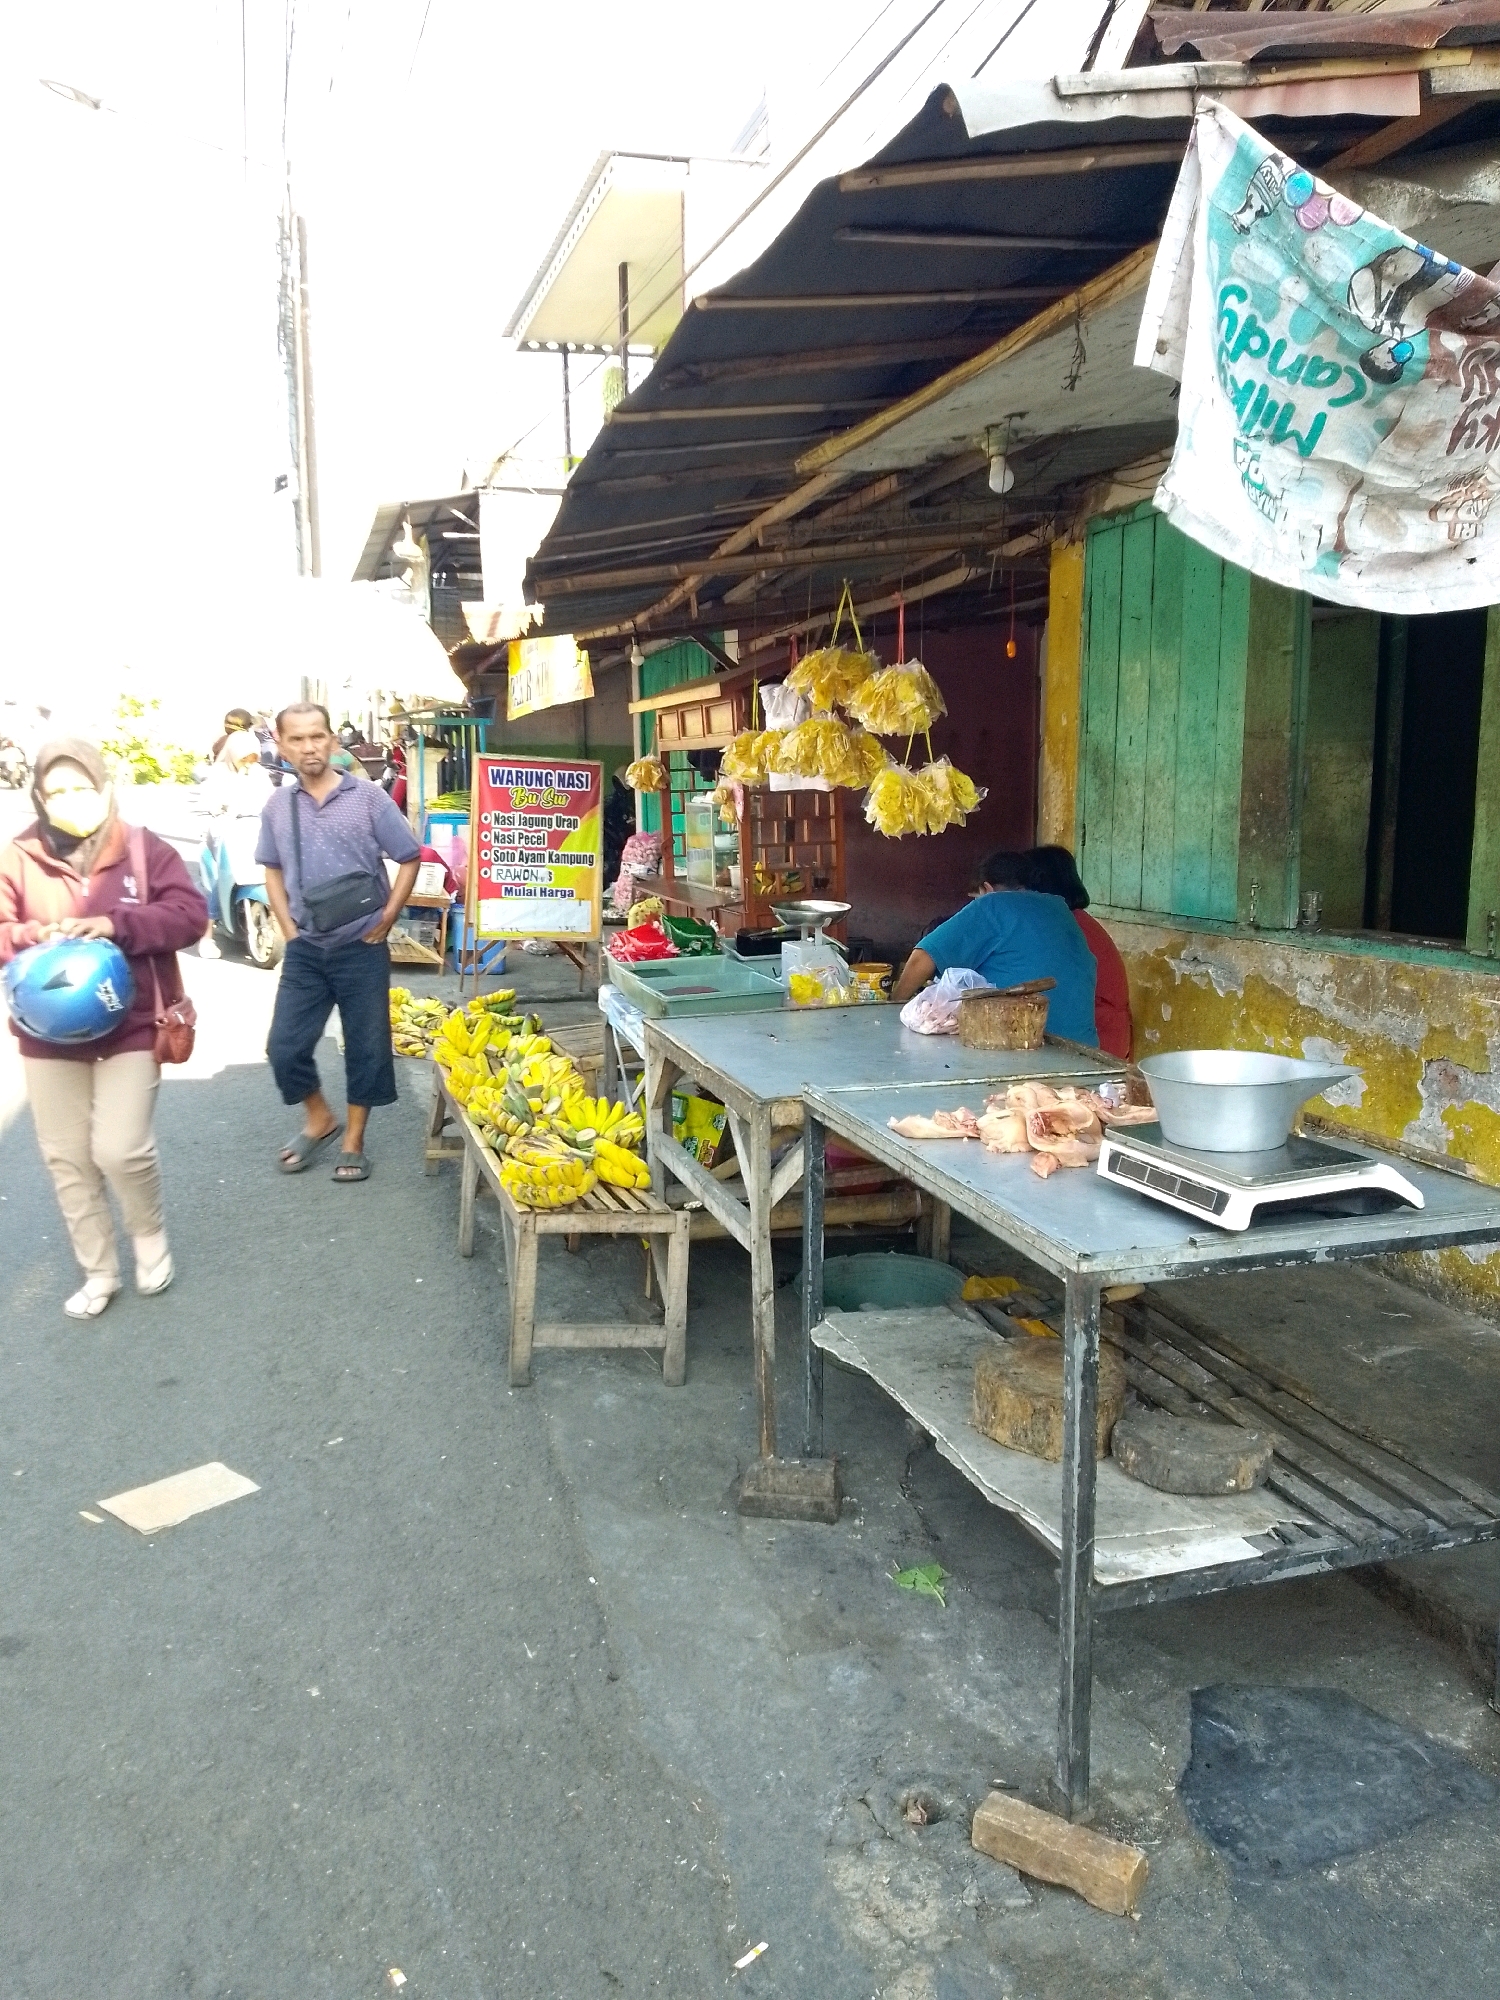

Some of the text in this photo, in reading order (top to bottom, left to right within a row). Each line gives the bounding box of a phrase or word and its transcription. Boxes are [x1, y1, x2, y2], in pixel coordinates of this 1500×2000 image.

[1217, 284, 1367, 408] Candy
[490, 768, 590, 790] WARUNG NASI
[511, 786, 539, 808] Bu
[493, 812, 579, 830] Nasi Jagung Urap
[493, 831, 546, 846] Nasi Pecel
[493, 849, 594, 866] Soto Ayam Kampung
[496, 868, 539, 881] RAWON
[504, 886, 574, 899] Mulai Harga
